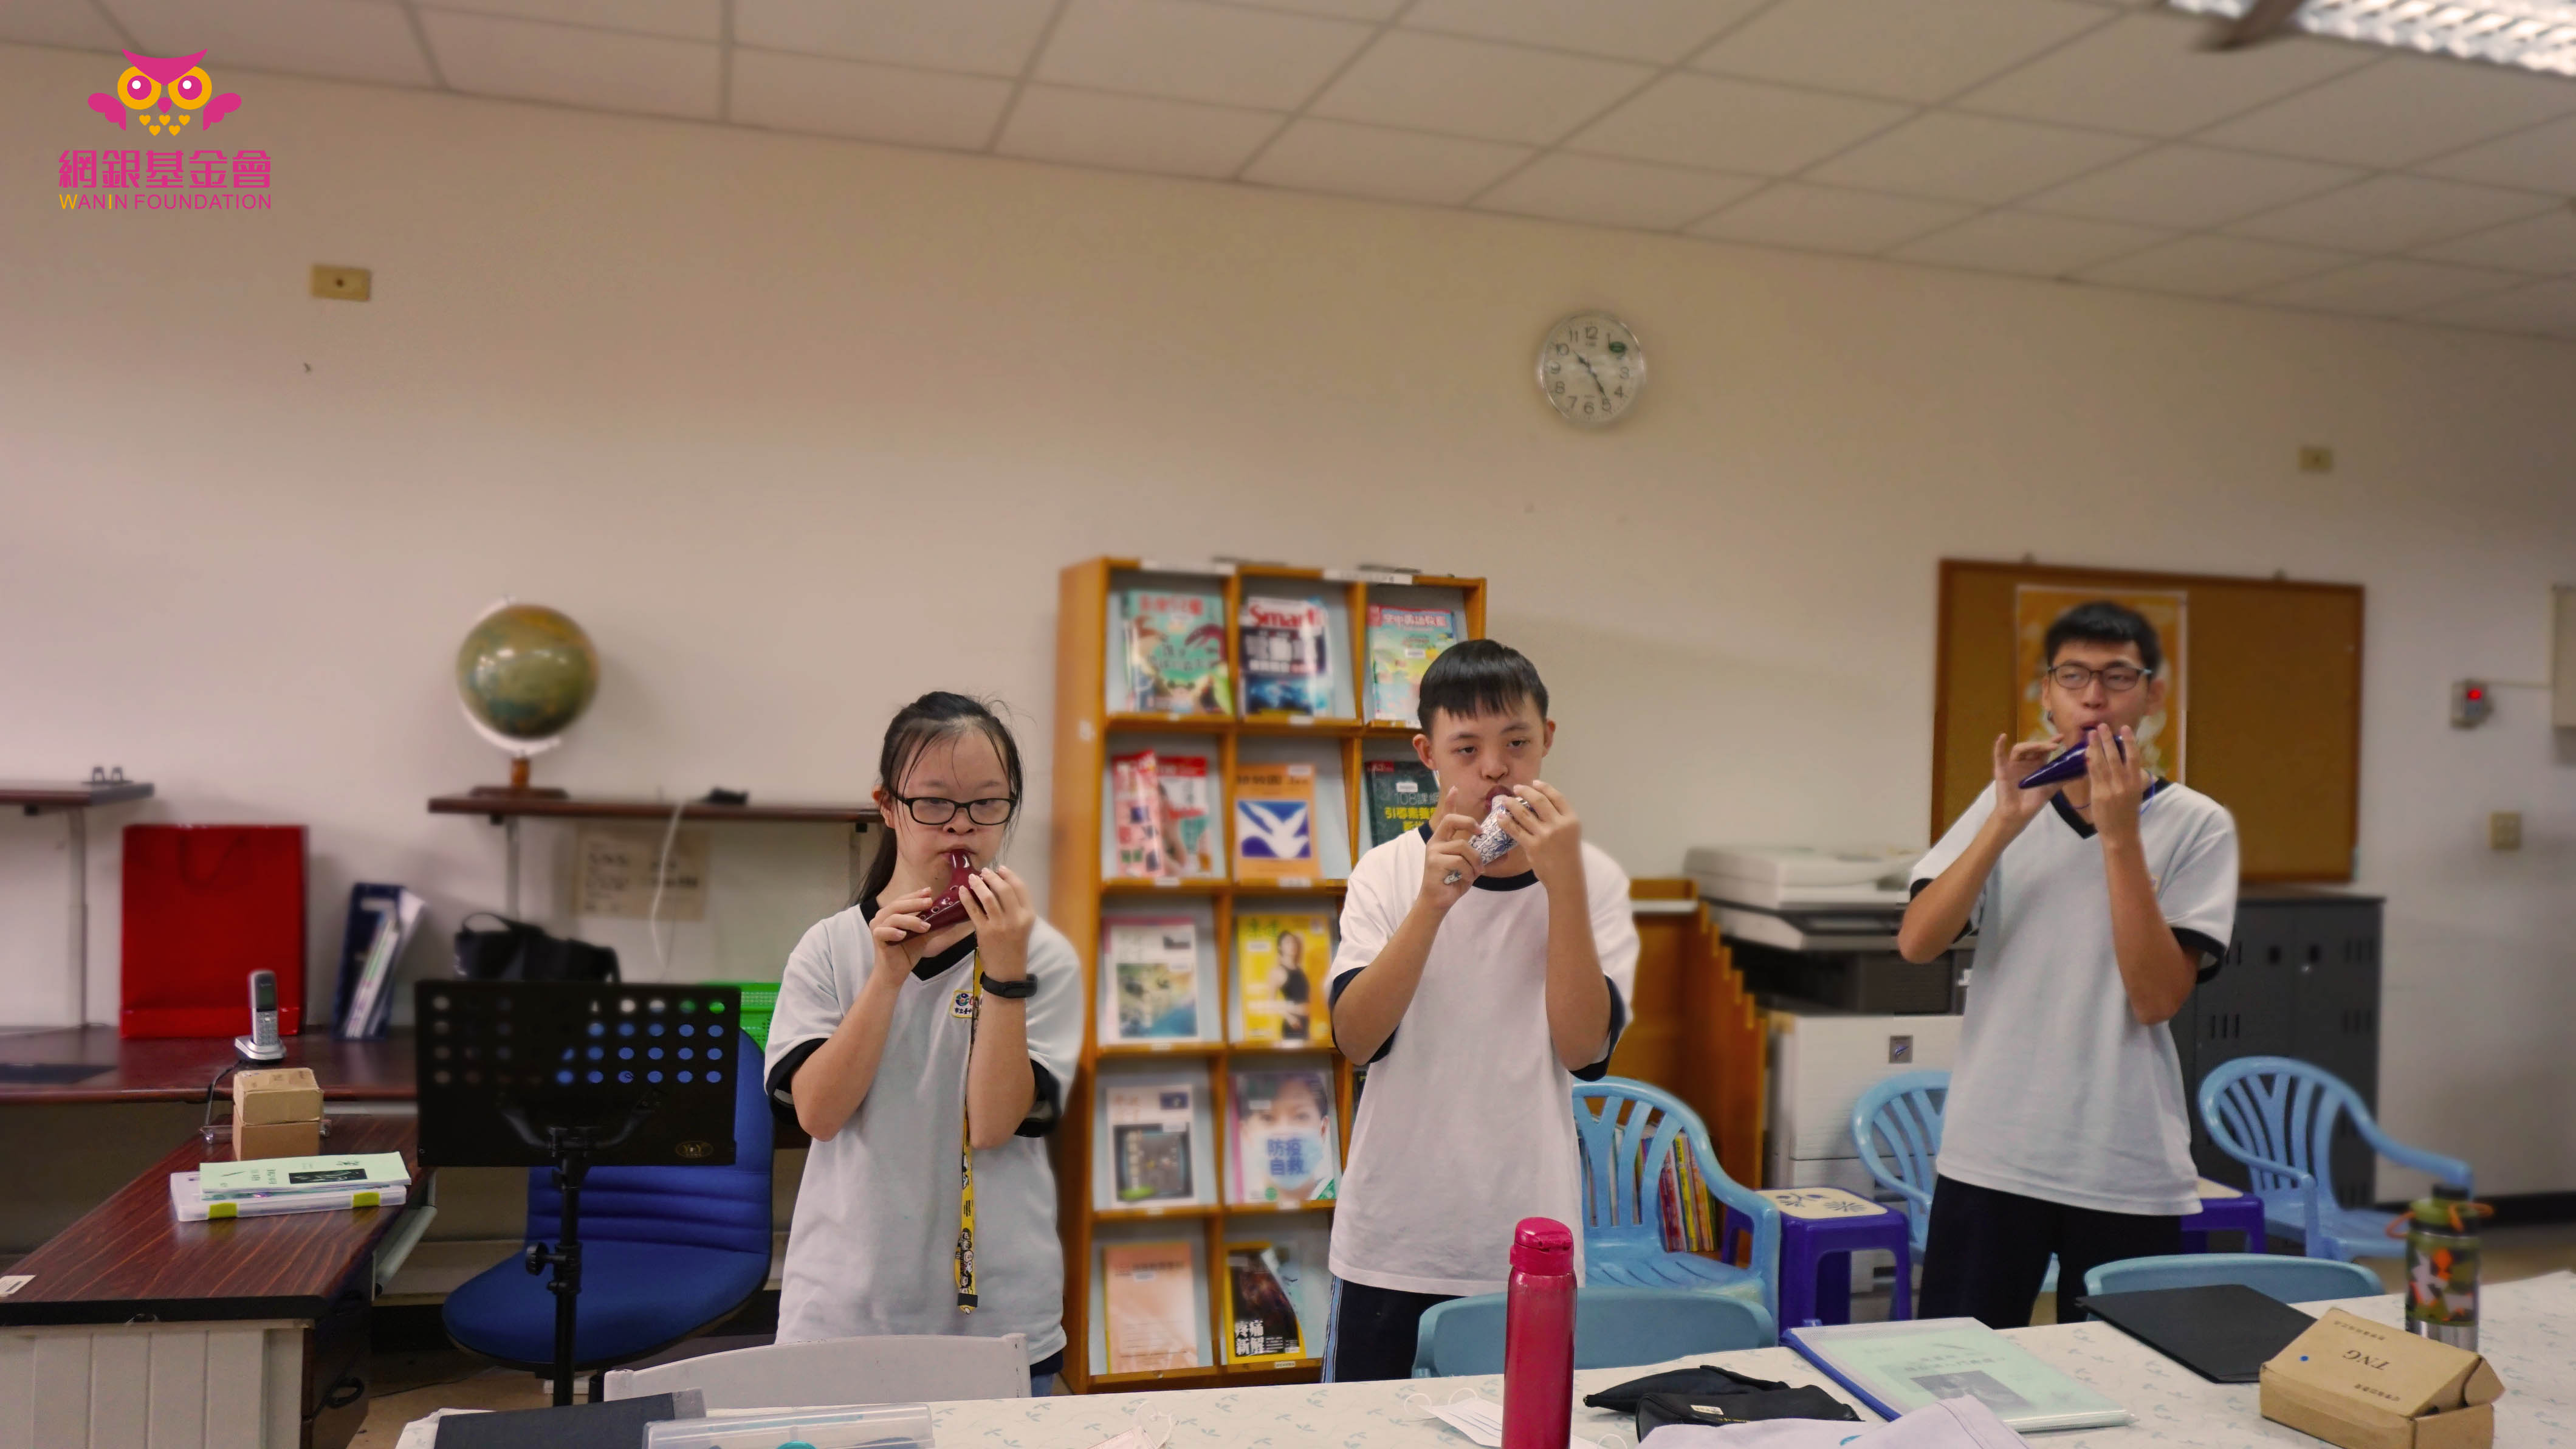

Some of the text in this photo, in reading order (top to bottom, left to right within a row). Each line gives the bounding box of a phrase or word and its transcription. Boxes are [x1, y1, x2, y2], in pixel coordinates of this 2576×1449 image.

[1569, 329, 1579, 343] 11
[1585, 326, 1598, 340] 12
[1556, 343, 1570, 356] 10
[1550, 362, 1561, 375] 9
[1619, 367, 1629, 380] 3
[1555, 381, 1565, 394] 8
[1614, 385, 1624, 398] 4
[1568, 396, 1578, 409] 7
[1584, 402, 1594, 415] 6
[1235, 1319, 1264, 1338] 疼痛
[1235, 1337, 1265, 1355] 新解
[2342, 1349, 2390, 1371] TNG
